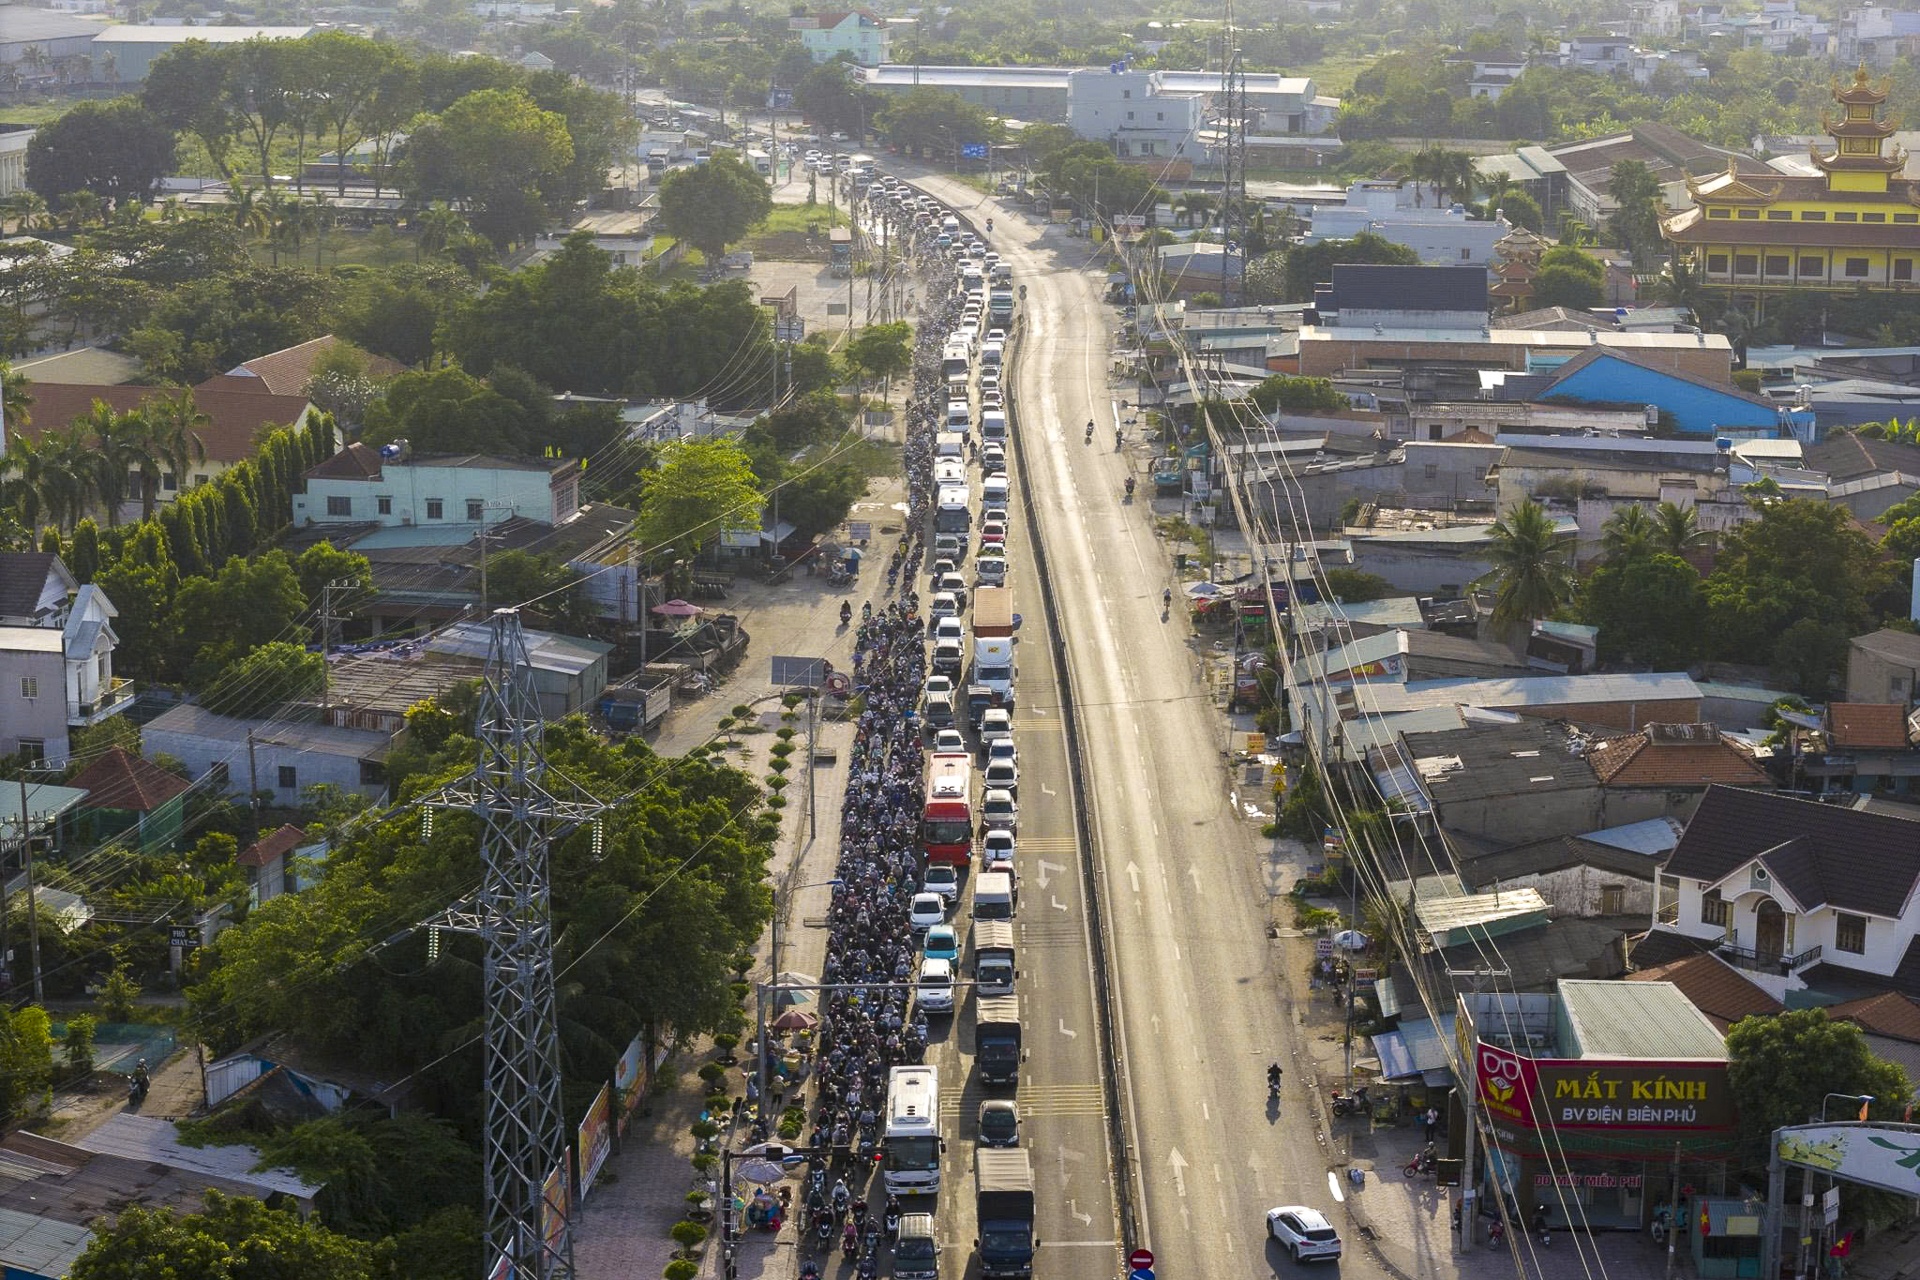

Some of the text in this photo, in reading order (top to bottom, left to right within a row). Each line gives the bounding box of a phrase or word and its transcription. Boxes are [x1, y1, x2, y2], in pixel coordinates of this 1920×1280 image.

[1555, 1071, 1707, 1100] MẮT KÍNH
[1563, 1104, 1696, 1124] BV ĐIỆN BIÊN PHỦ
